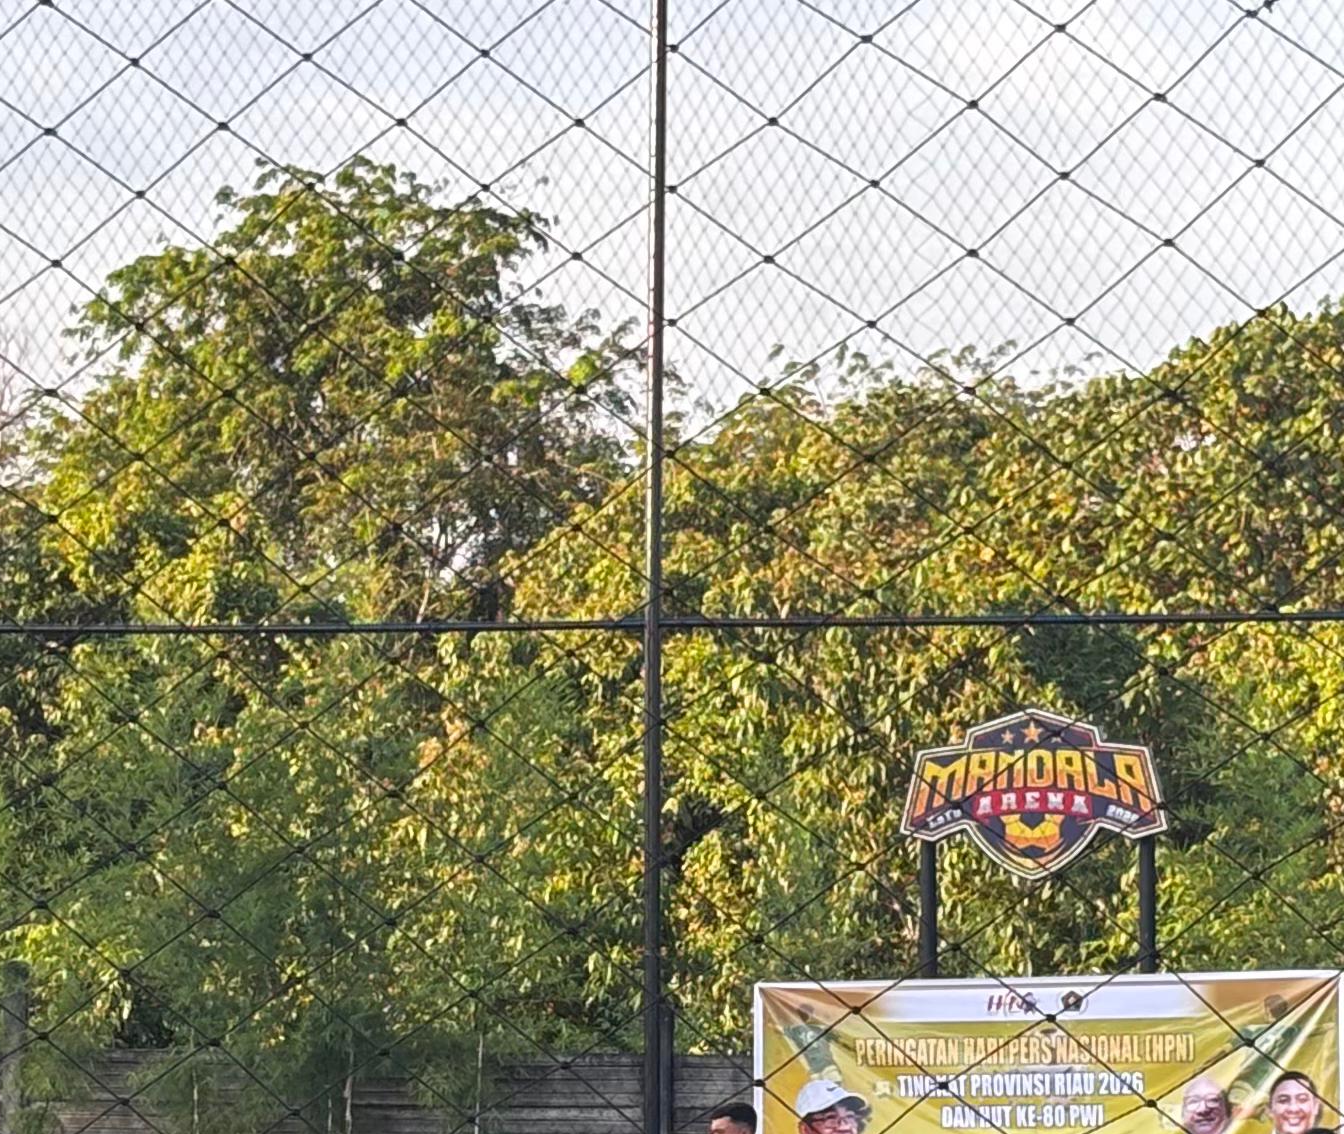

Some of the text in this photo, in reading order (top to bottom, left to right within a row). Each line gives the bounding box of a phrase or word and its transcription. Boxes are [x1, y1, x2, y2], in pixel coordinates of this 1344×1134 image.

[913, 749, 1153, 817] MANDALA
[977, 790, 1089, 815] ARENA
[855, 1036, 959, 1067] PERINGATAN
[963, 1036, 1006, 1066] HARI
[1008, 1035, 1052, 1065] PERS
[1056, 1034, 1141, 1064] NASIONAL
[896, 1072, 1144, 1098] TINGKAT PROVINSI RIAU 2026
[941, 1104, 1105, 1129] DAN HUT KE-80 PWI
